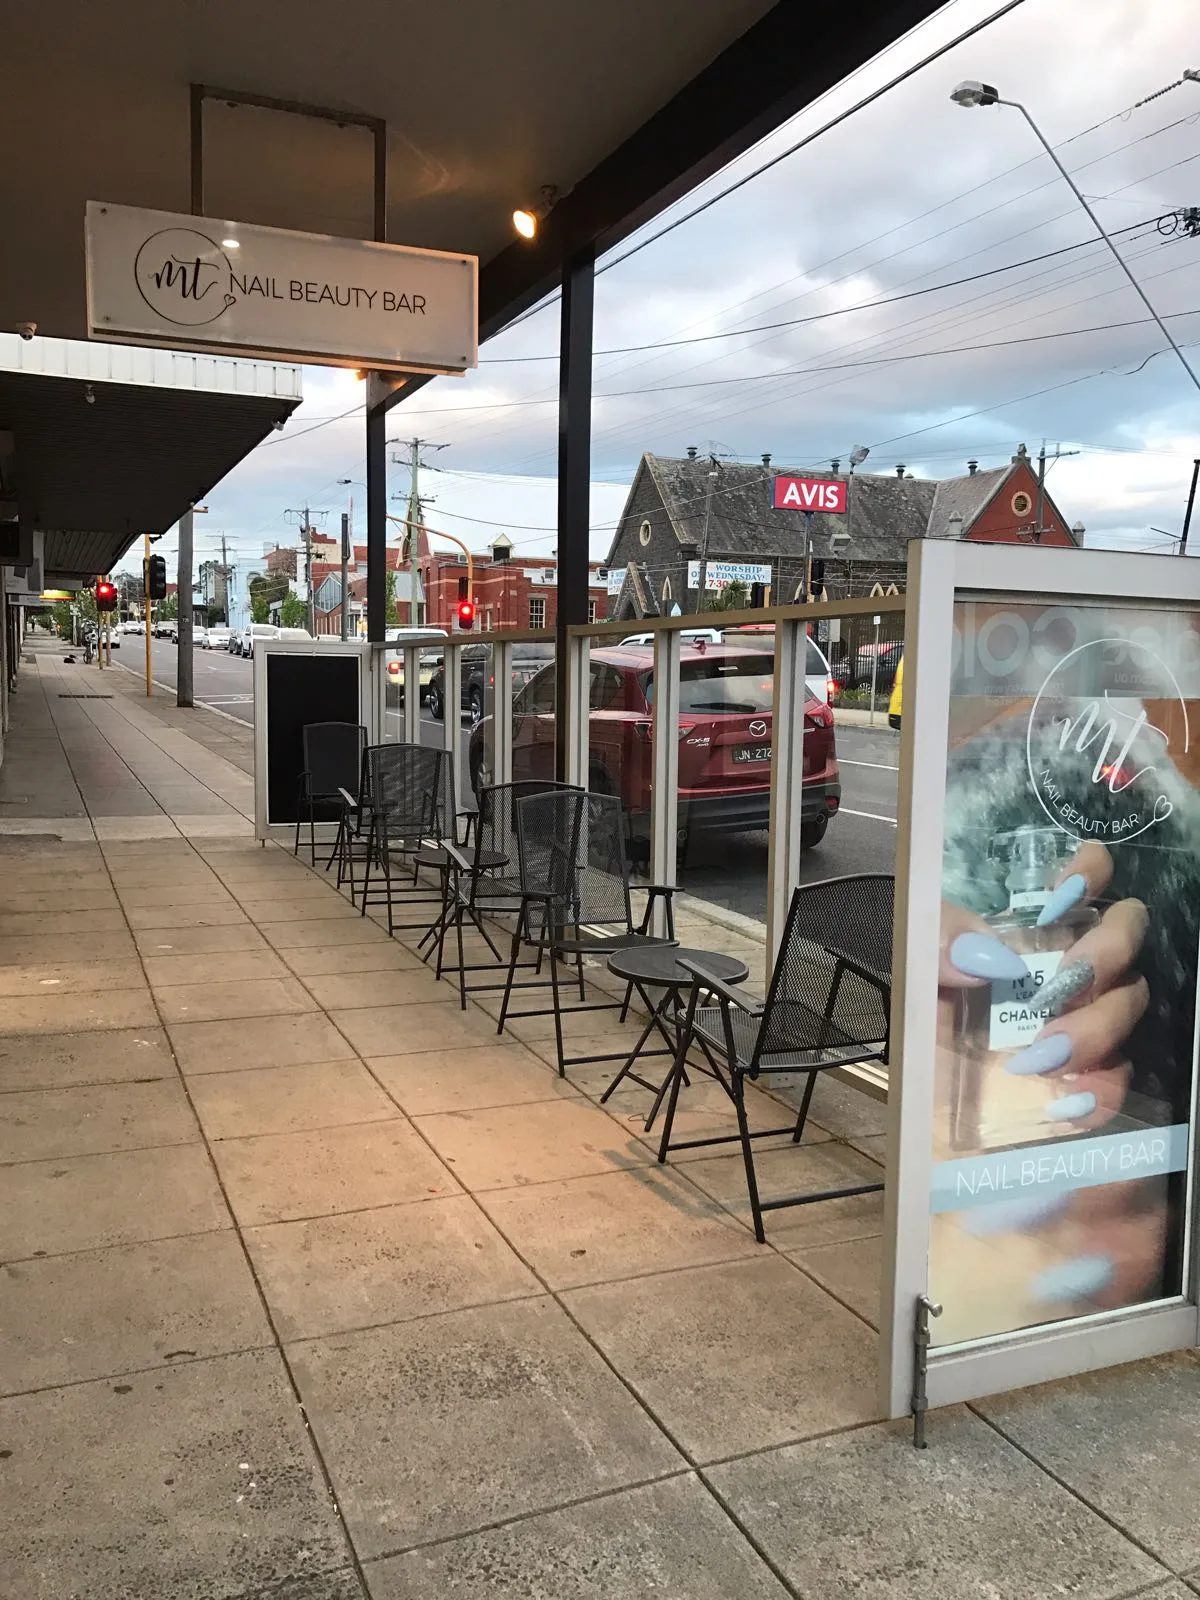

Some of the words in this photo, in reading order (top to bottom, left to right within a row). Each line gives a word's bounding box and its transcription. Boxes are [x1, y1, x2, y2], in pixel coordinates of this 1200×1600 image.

[230, 272, 283, 300] NAIL
[290, 280, 377, 310] BEAUTY
[384, 291, 426, 315] BAR
[783, 482, 839, 508] AVIS
[716, 564, 763, 574] WORSHIP
[1040, 769, 1061, 809] NAIL
[1060, 803, 1109, 833] BEAUTY
[1112, 813, 1139, 833] BAR
[999, 1007, 1056, 1023] CHANEL
[1017, 1024, 1037, 1032] PARIS
[956, 1165, 1014, 1197] NAIL
[1020, 1147, 1114, 1187] BEAUTY
[1119, 1139, 1167, 1170] BAR
